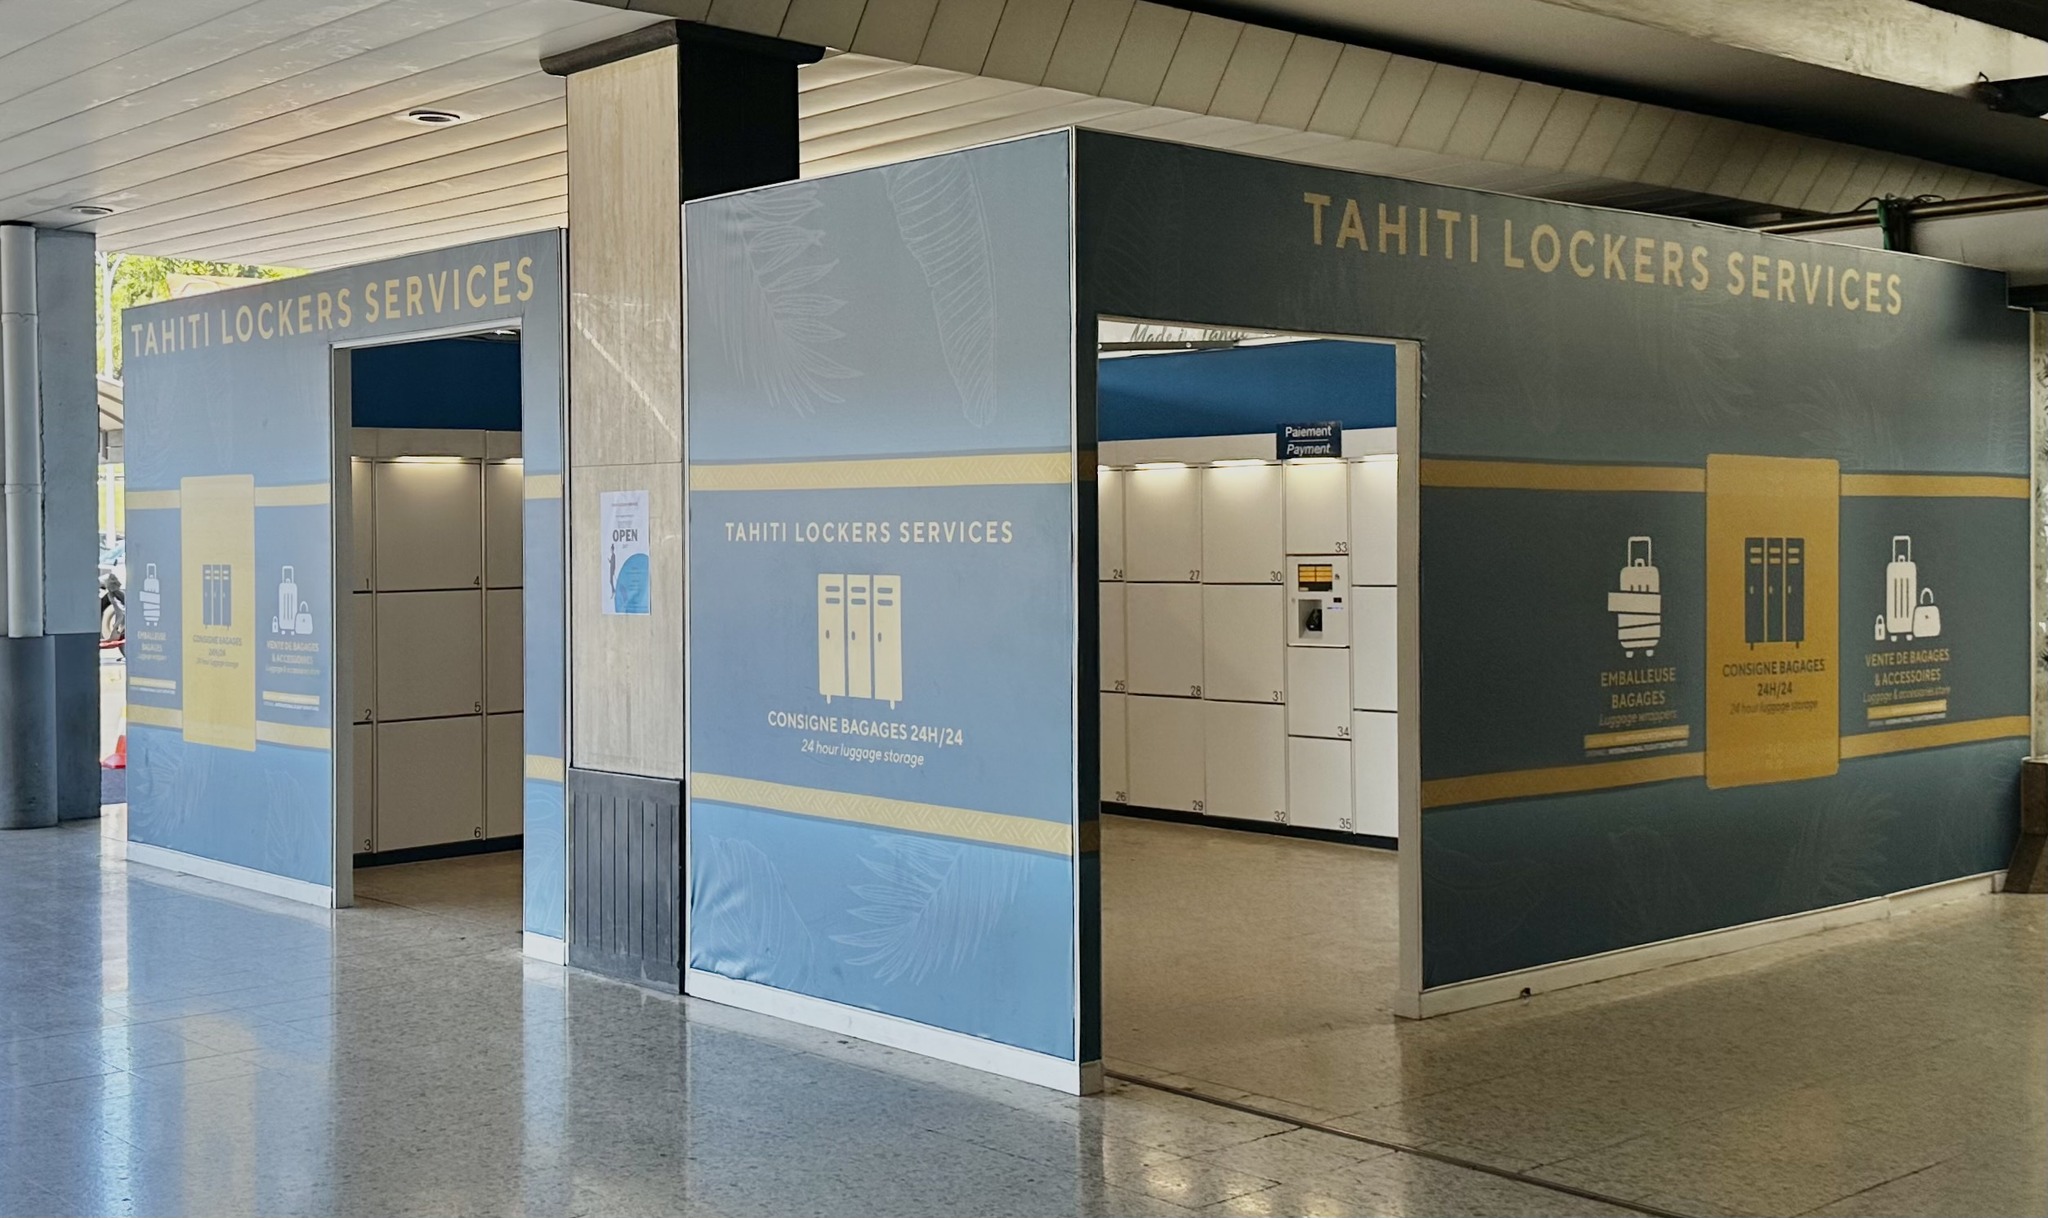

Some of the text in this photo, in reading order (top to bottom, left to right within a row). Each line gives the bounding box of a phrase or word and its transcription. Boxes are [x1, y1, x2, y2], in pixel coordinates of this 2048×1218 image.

[1304, 192, 1902, 316] TAHITI LOCKERS SERVICES
[131, 256, 535, 357] TAHITI LOCKERS SERVICES
[1285, 425, 1332, 438] Paiement
[1286, 443, 1331, 457] Payment
[612, 528, 638, 542] OPEN
[725, 520, 1014, 544] TAHITI LOCKERS SERVICES
[1335, 541, 1348, 553] 33
[1112, 569, 1124, 579] 24
[1189, 570, 1201, 581] 27
[1270, 571, 1283, 582] 30
[473, 575, 480, 586] 4
[1865, 648, 1950, 667] VENTE DE BAGAGES
[1722, 659, 1825, 677] CONSIGNE BAGAGES
[1601, 667, 1677, 687] EMBALLEUSE
[1881, 668, 1941, 686] ACCESSOIRES
[1114, 680, 1126, 691] 25
[1190, 685, 1202, 696] 28
[1757, 682, 1793, 699] 24H/24
[1272, 691, 1283, 701] 31
[1612, 690, 1666, 709] BAGAGES
[474, 701, 481, 712] 5
[364, 709, 372, 721] 2
[1599, 713, 1638, 728] Luggage
[768, 710, 963, 748] CONSIGNE BAGAGES 24H/24
[1337, 725, 1350, 737] 34
[801, 739, 924, 769] 24 hour luggage storage
[1115, 791, 1127, 802] 26
[1192, 800, 1204, 811] 29
[1274, 811, 1286, 823] 32
[1339, 817, 1351, 830] 35
[474, 826, 482, 838] 6
[363, 839, 372, 851] 3
